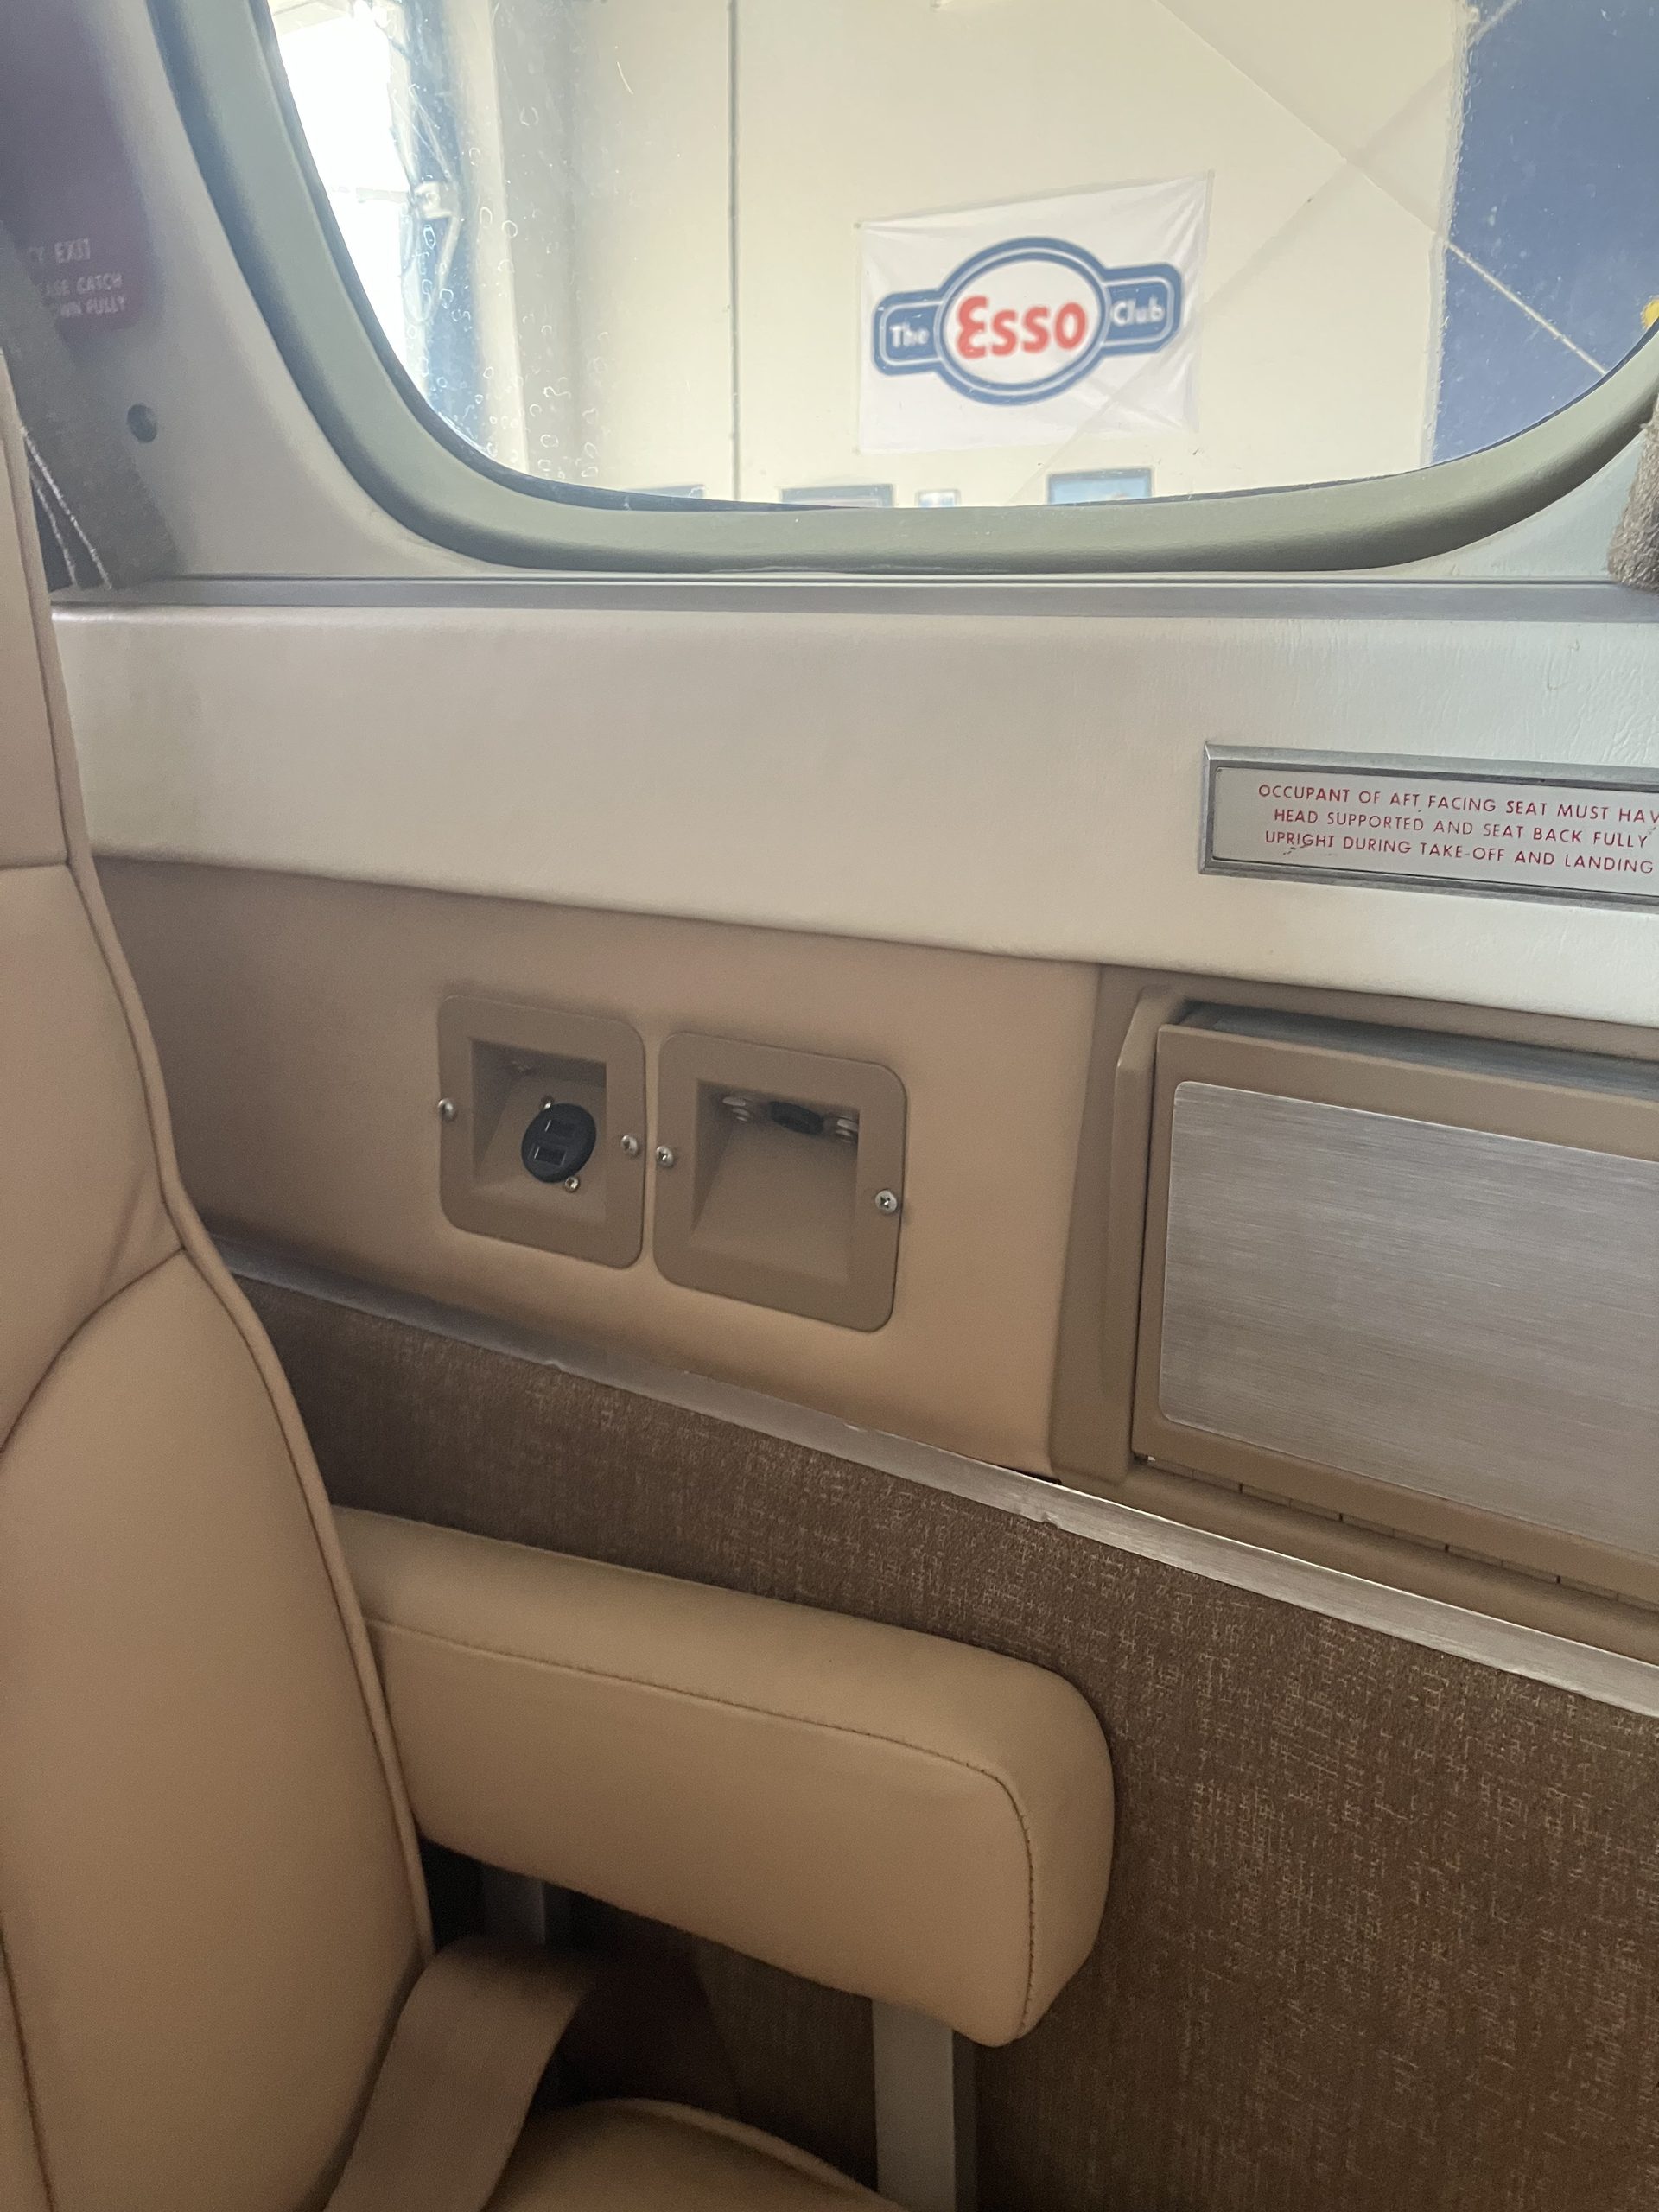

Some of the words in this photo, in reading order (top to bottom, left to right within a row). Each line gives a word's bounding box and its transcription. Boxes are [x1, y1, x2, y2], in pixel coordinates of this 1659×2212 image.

[54, 238, 90, 263] EXIT
[76, 273, 123, 294] CATCH
[86, 296, 125, 315] FULLY
[890, 323, 929, 347] The
[1112, 295, 1164, 326] Club
[1258, 784, 1350, 803] OCCUPANT
[1358, 791, 1381, 804] OF
[1389, 792, 1420, 807] AFT
[1427, 795, 1496, 813] FACING
[1506, 800, 1548, 816] SEAT
[1557, 804, 1609, 820] MUST
[1274, 809, 1318, 823] HEAD
[1326, 812, 1424, 831] SUPPORTED
[1433, 820, 1473, 835] AND
[1484, 823, 1524, 839] SEAT
[1533, 827, 1583, 844] BACK
[1593, 831, 1648, 849] FULLY
[1265, 830, 1335, 848] UPRIGHT
[1343, 836, 1412, 854] DURING
[1420, 842, 1505, 861] TAKE-OFF
[1514, 850, 1554, 865] AND
[1565, 854, 1654, 874] LANDING
